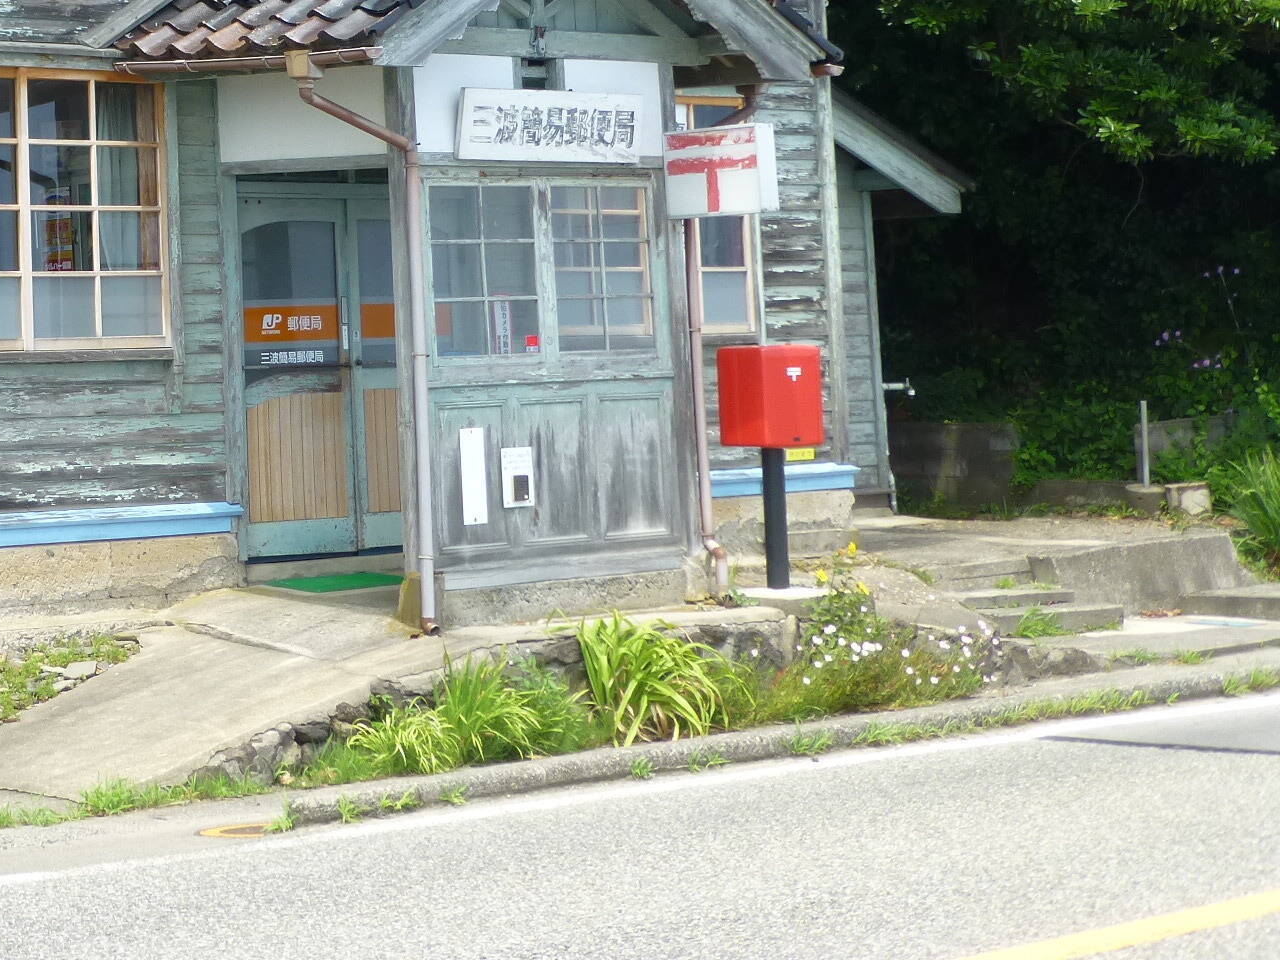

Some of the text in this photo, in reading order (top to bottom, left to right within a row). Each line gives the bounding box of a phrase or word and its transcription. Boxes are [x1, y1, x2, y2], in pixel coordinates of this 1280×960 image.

[470, 104, 635, 149] 三波簡易郵便局
[262, 314, 322, 331] JP 郵便局
[260, 350, 324, 364] 三波簡易郵便局
